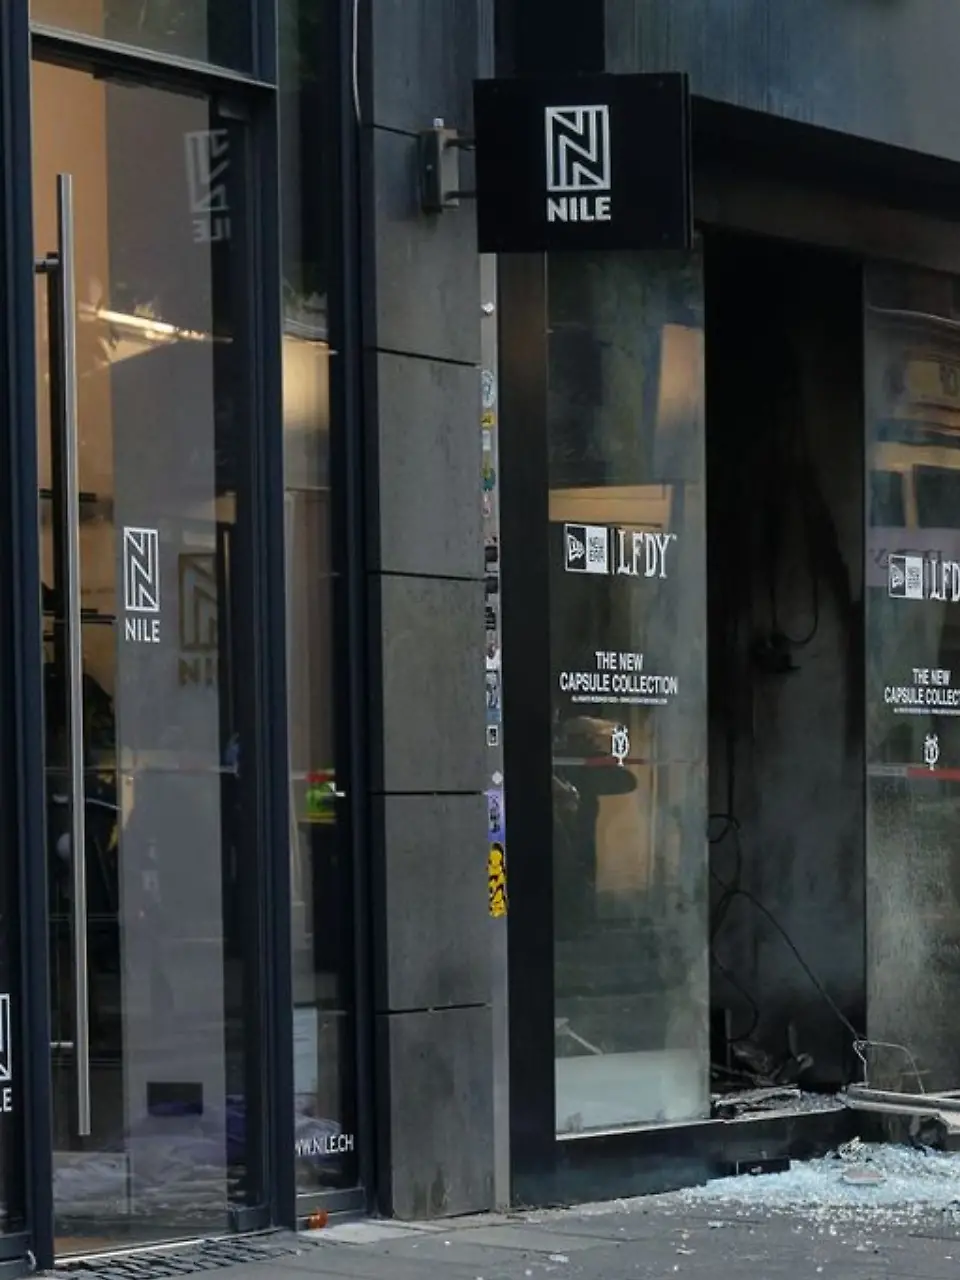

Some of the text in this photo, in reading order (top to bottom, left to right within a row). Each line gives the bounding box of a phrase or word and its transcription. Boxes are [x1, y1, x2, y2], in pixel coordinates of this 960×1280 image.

[547, 197, 611, 222] NILE
[125, 617, 161, 643] NILE
[595, 651, 643, 671] THE NEW
[560, 672, 678, 694] CAPSULE COLLECTION
[912, 668, 951, 686] THE NEW
[884, 687, 924, 704] CAPSULE
